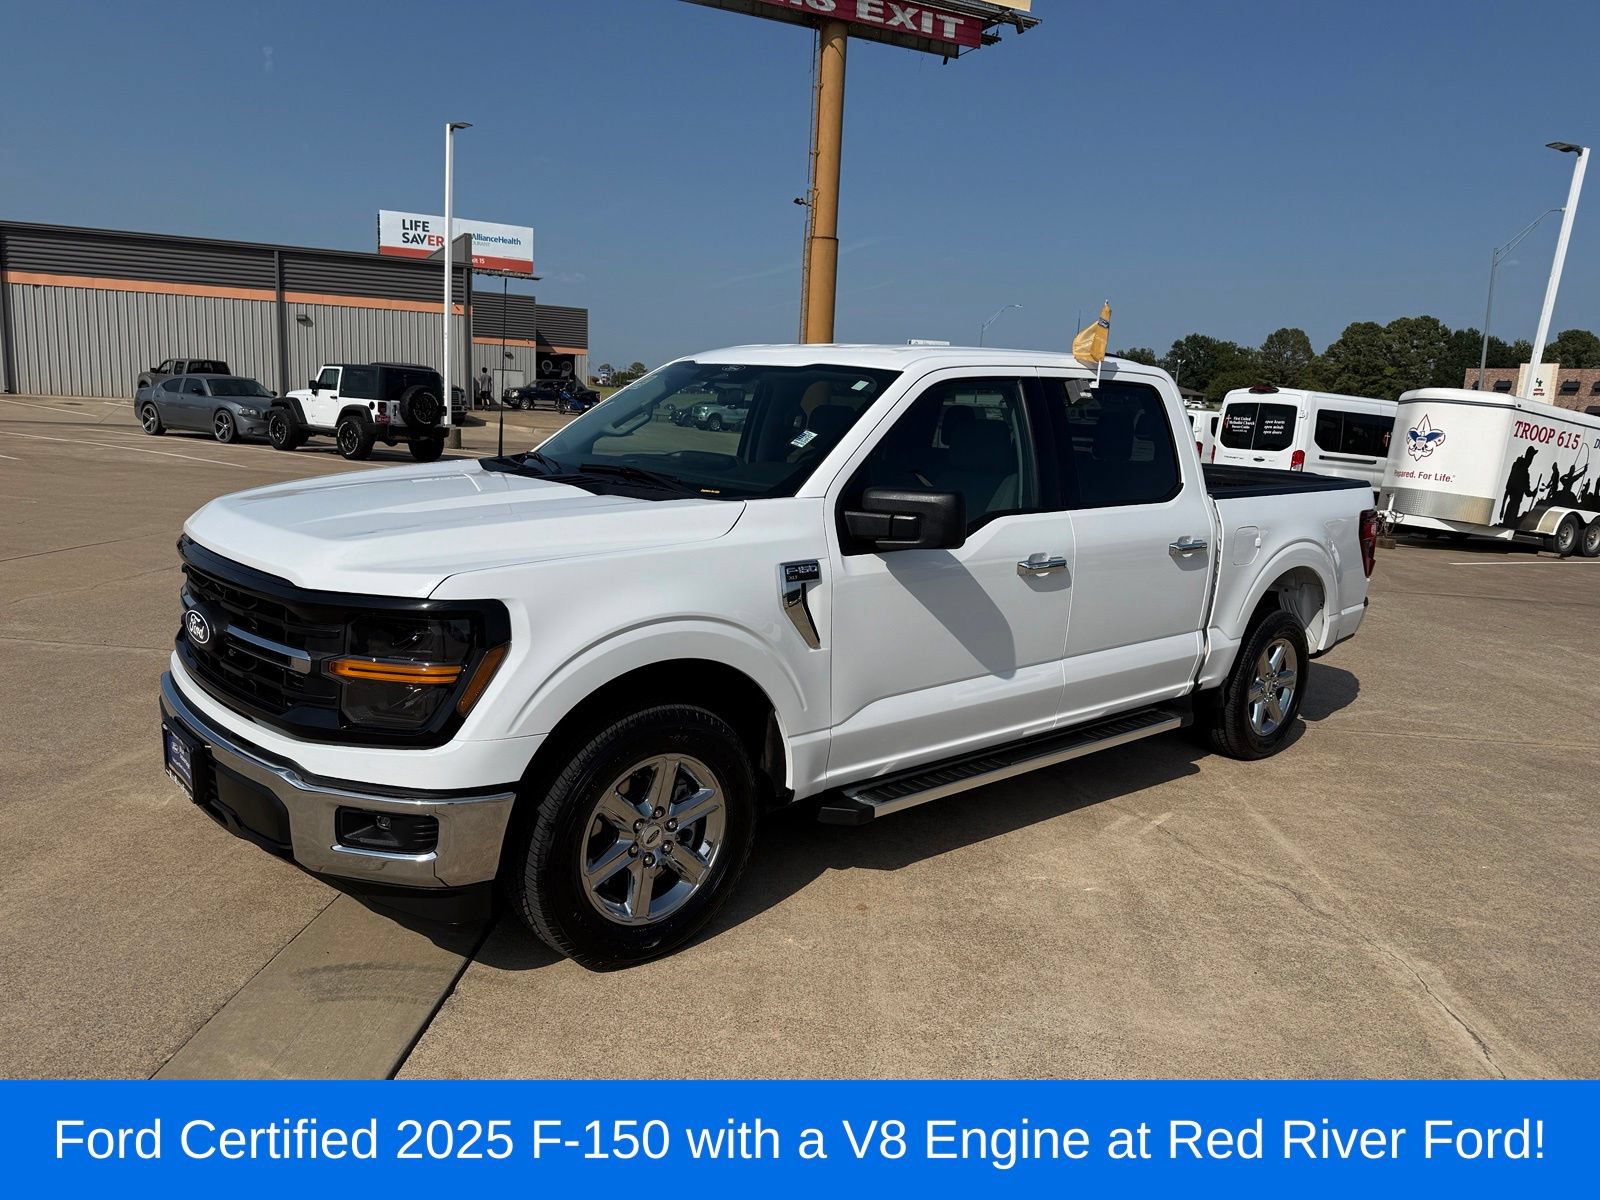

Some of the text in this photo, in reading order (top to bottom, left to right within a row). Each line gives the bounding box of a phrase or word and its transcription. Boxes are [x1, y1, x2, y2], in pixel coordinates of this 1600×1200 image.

[856, 0, 965, 39] EXIT
[402, 218, 430, 233] LIFE
[401, 232, 445, 247] SAVER
[472, 232, 522, 246] AllianceHealth
[1513, 420, 1556, 444] TROOP
[1557, 431, 1581, 450] 615
[1417, 471, 1433, 480] For
[1434, 472, 1453, 483] Life.
[786, 565, 817, 575] F-150
[188, 612, 206, 641] Ford
